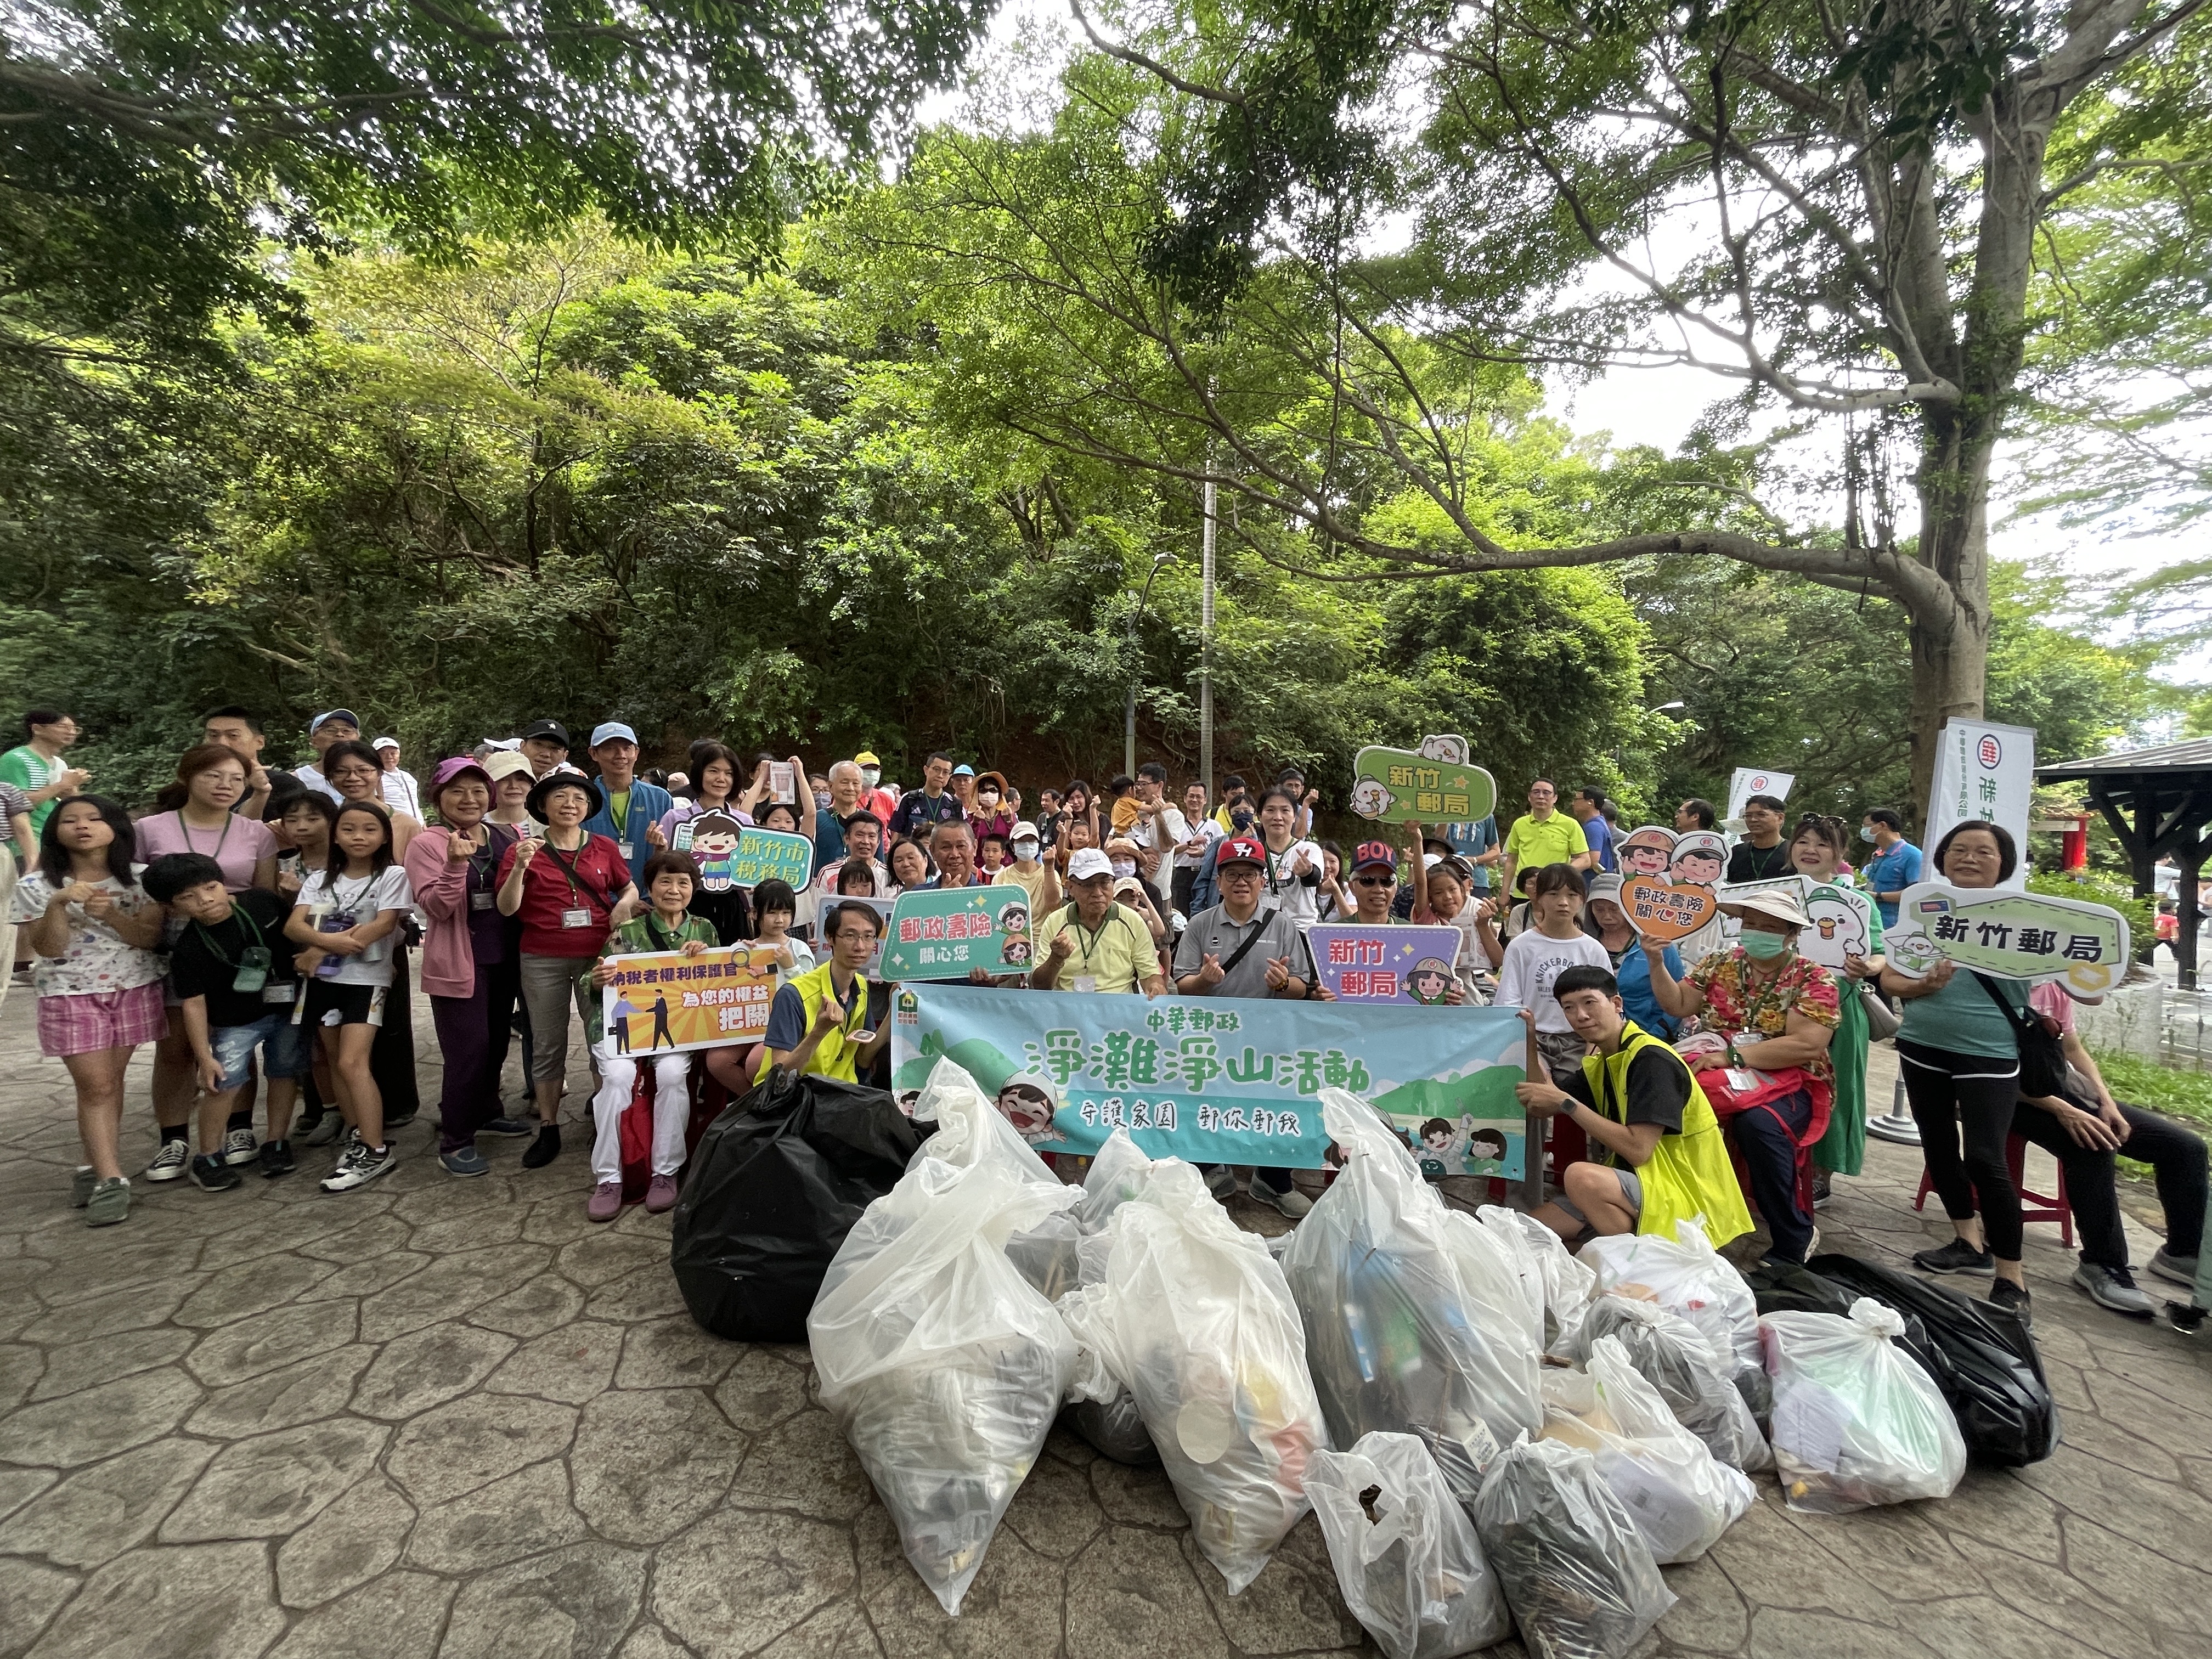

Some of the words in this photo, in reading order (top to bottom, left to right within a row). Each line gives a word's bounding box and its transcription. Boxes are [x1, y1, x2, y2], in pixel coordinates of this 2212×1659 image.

[1389, 765, 1441, 789] 新竹
[1416, 792, 1470, 816] 郵局
[741, 835, 808, 862] 新竹市
[1357, 840, 1393, 862] BOY
[1634, 887, 1704, 912] 郵政壽險
[900, 912, 992, 943] 郵政壽險
[1635, 903, 1693, 926] 關心您
[1329, 939, 1386, 966] 新竹
[1934, 915, 2102, 963] 新竹郵局
[919, 945, 969, 964] 關心您
[682, 985, 769, 1008] 為您的權益
[1341, 970, 1398, 998] 郵局
[719, 1003, 770, 1031] 把關
[1147, 1006, 1240, 1035] 中華郵政
[1024, 1030, 1370, 1096] 淨灘淨山活動
[1082, 1099, 1176, 1130] 守護家園
[1199, 1106, 1300, 1135] 郵你郵我
